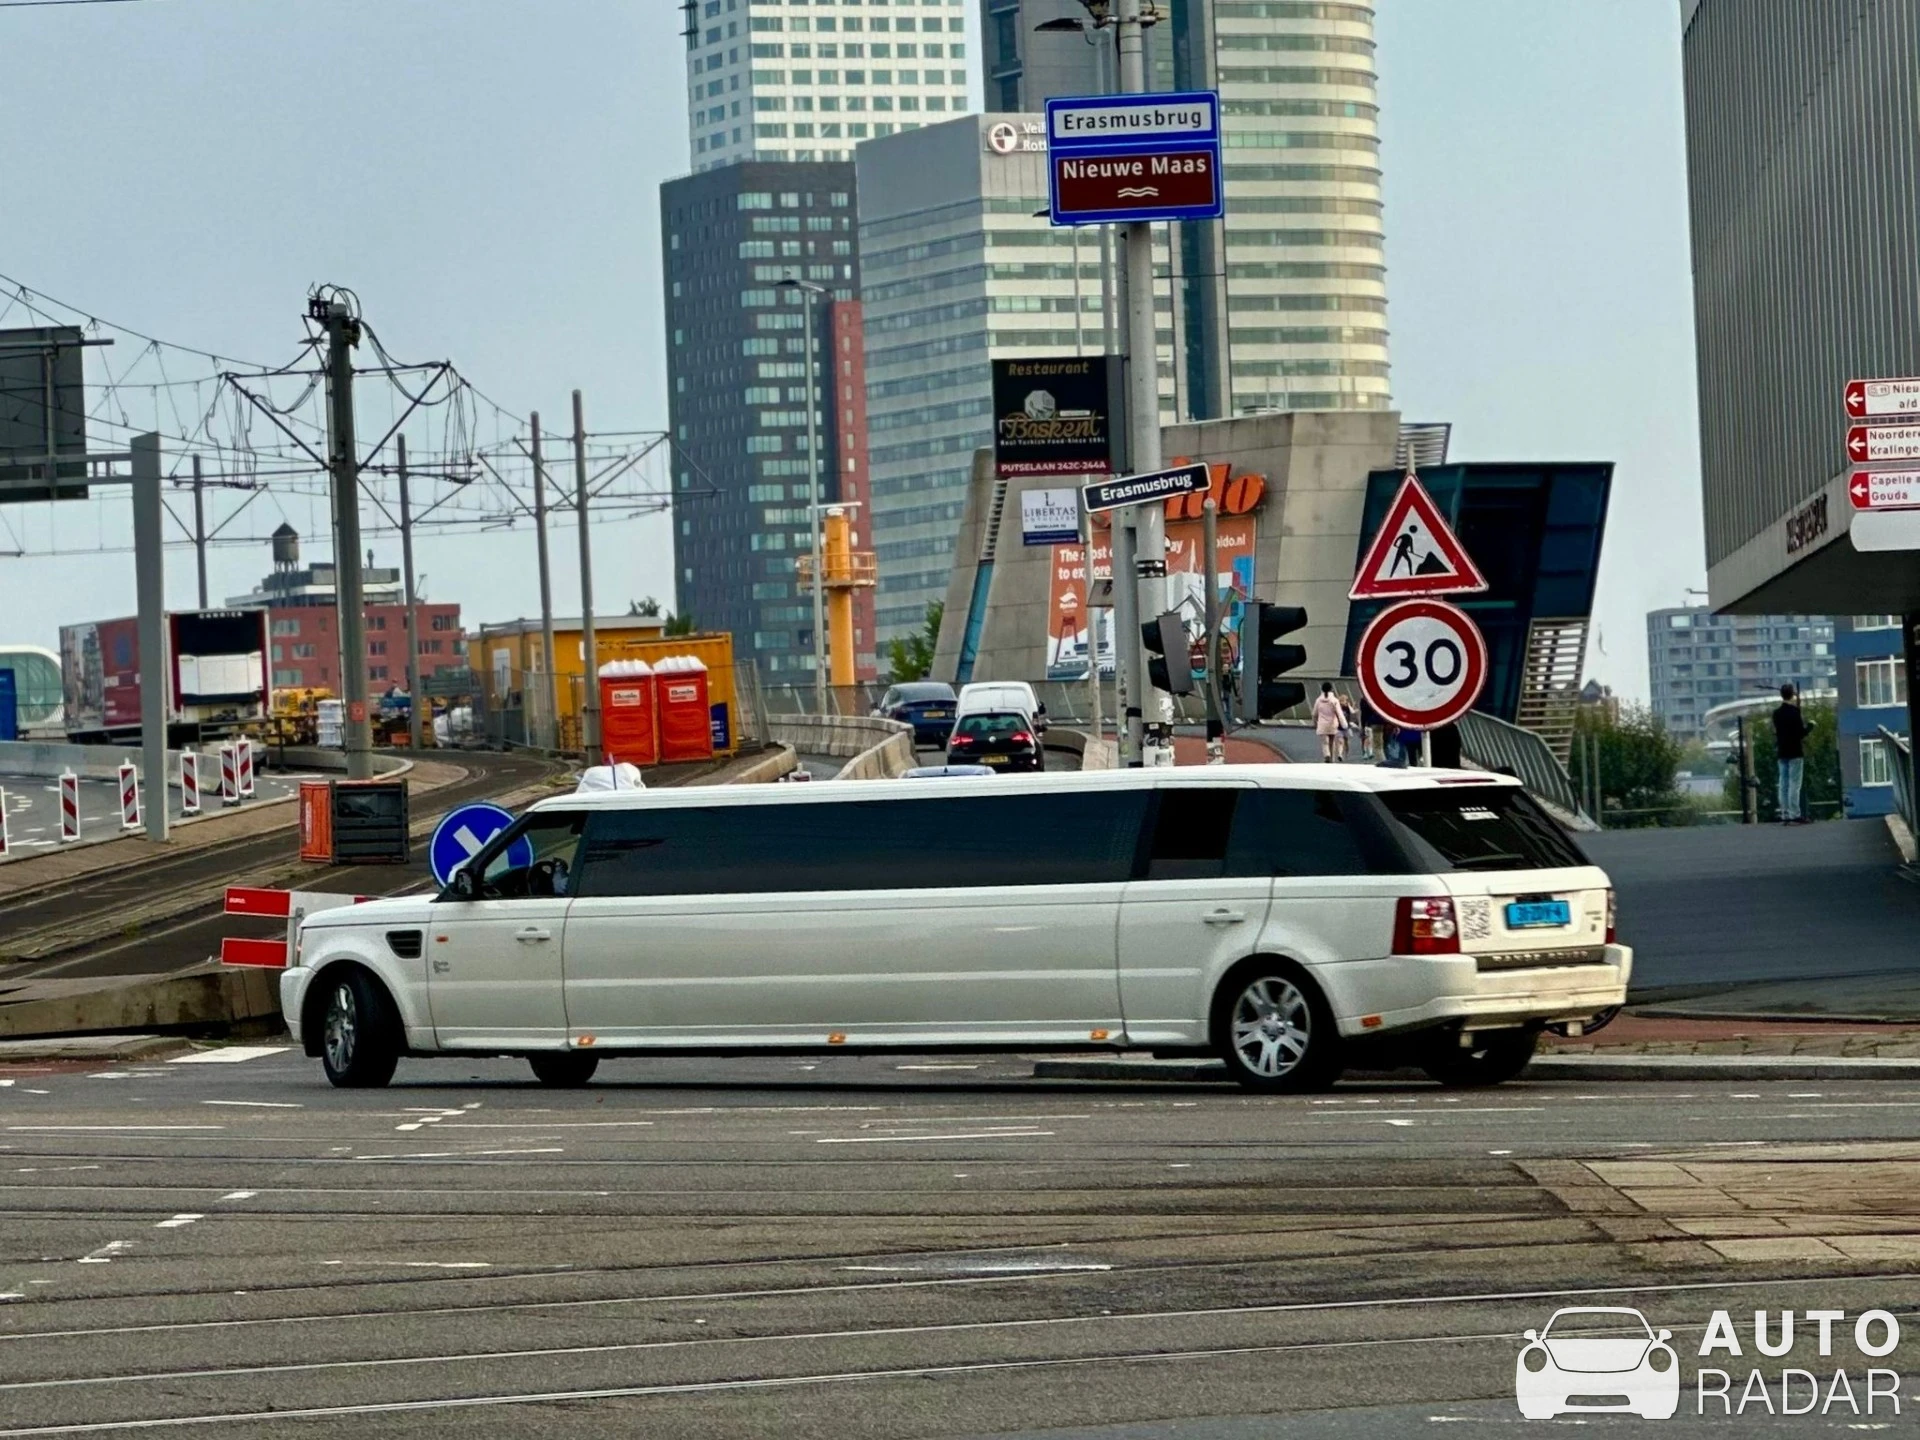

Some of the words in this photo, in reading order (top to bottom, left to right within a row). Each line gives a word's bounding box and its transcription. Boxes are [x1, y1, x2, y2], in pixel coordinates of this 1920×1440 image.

[1063, 109, 1202, 130] Erasmusbrug
[1063, 160, 1143, 179] Nieuwe
[1151, 157, 1207, 175] Maas
[1008, 361, 1090, 375] Restaurant
[1899, 399, 1918, 408] a/d
[1001, 463, 1056, 472] PUTSELAAN
[1100, 473, 1193, 501] Erasmusbrug
[1871, 476, 1912, 486] Capelle
[1871, 491, 1908, 501] Gouda
[1024, 507, 1076, 517] LIBERTAS
[1059, 549, 1079, 562] The
[1058, 567, 1070, 580] to
[1384, 638, 1462, 688] 30
